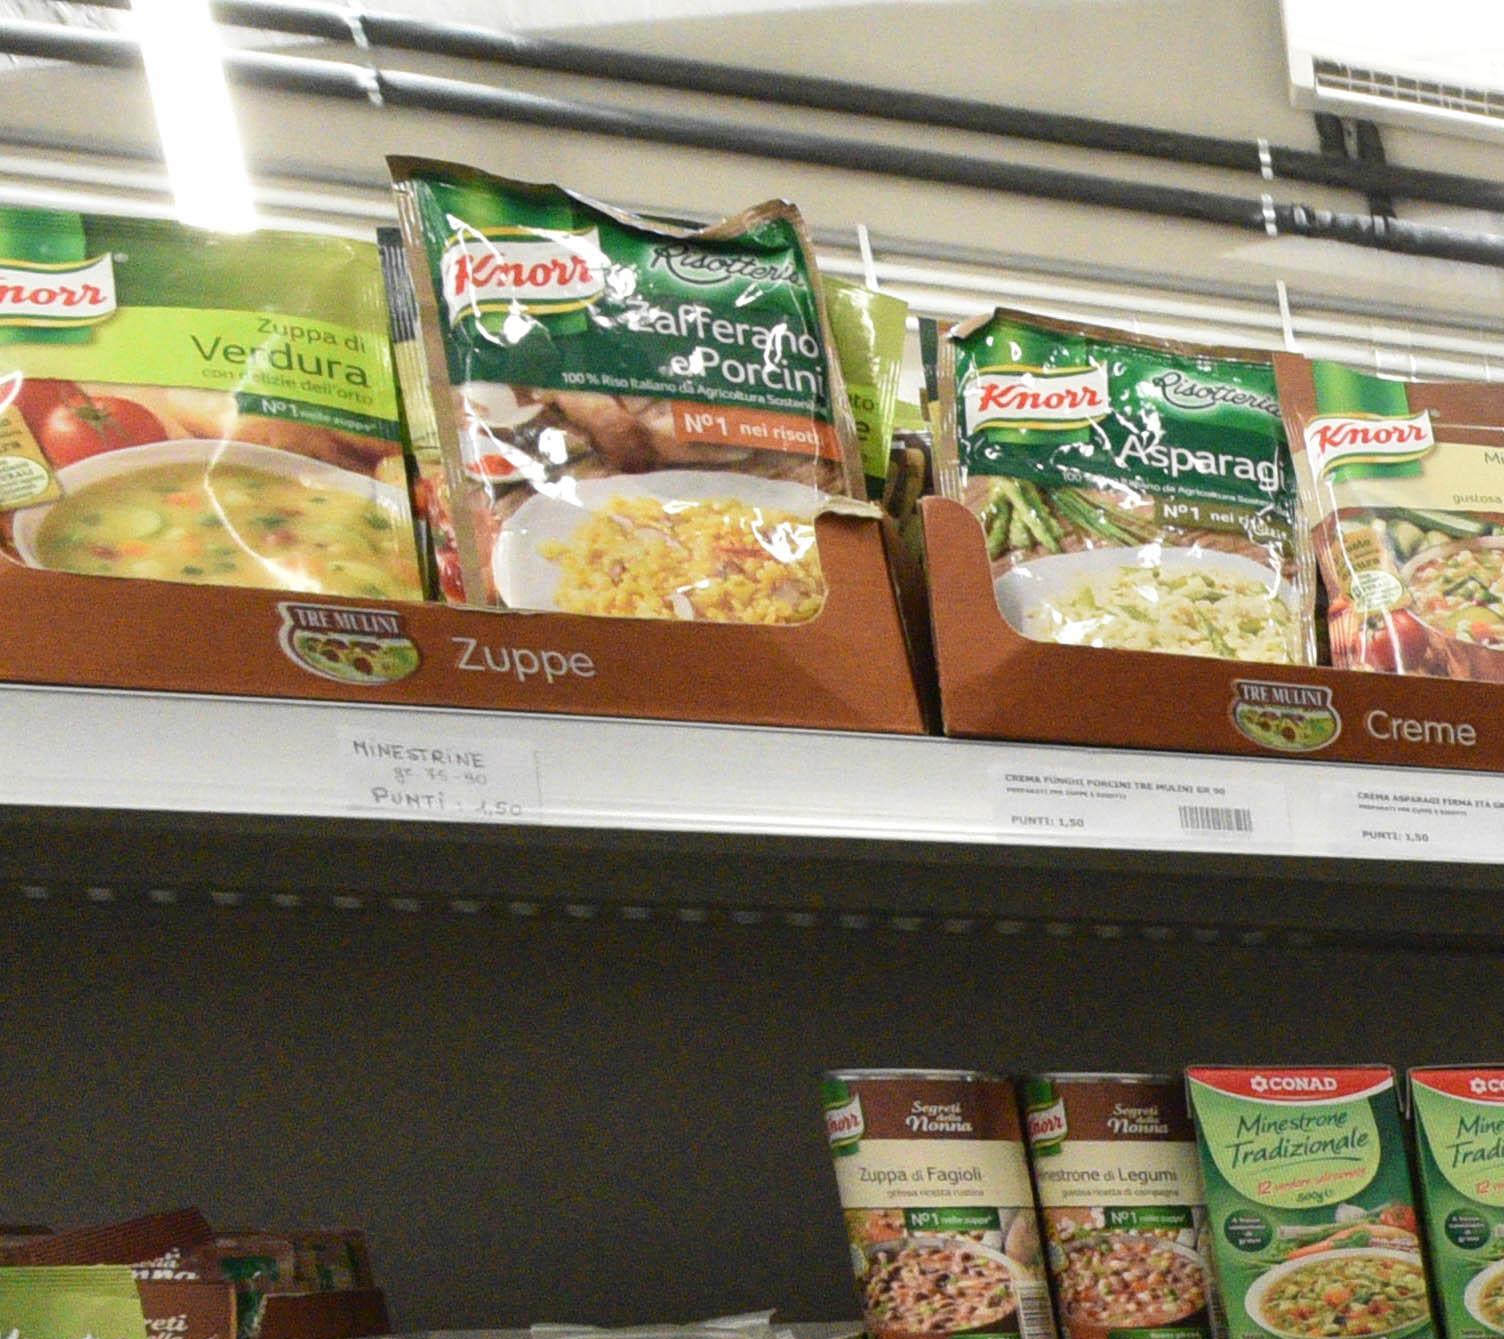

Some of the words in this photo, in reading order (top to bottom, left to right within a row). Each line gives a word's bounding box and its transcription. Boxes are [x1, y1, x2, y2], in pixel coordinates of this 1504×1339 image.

[455, 252, 593, 296] Knorr
[0, 282, 106, 306] norr
[258, 318, 337, 347] Zuppa
[345, 333, 366, 353] di
[624, 299, 818, 357] Zafferano
[192, 335, 369, 387] Verdura
[699, 348, 824, 397] Porcini
[979, 384, 1101, 411] Knorr
[739, 421, 769, 439] nei
[1312, 420, 1428, 453] Knorr
[1115, 436, 1287, 492] Asparagi
[299, 609, 332, 628] TRE
[334, 611, 399, 634] MULINI
[452, 637, 596, 683] Zuppe
[1241, 684, 1266, 702] TRE
[1271, 686, 1322, 706] MULINI
[1366, 710, 1476, 746] Creme
[1005, 774, 1040, 783] CREMA
[1358, 792, 1389, 801] CREMA
[1268, 1076, 1338, 1092] CONAD
[912, 1101, 961, 1115] Segreti
[906, 1115, 972, 1133] Nonna
[1107, 1118, 1168, 1135] Nonna
[1237, 1110, 1347, 1137] Minestrone
[1225, 1130, 1369, 1169] Tradizionale
[860, 1168, 907, 1188] Zuppa
[927, 1167, 981, 1188] Fagioli
[1117, 1169, 1178, 1188] Legumi
[1257, 1181, 1272, 1196] 12
